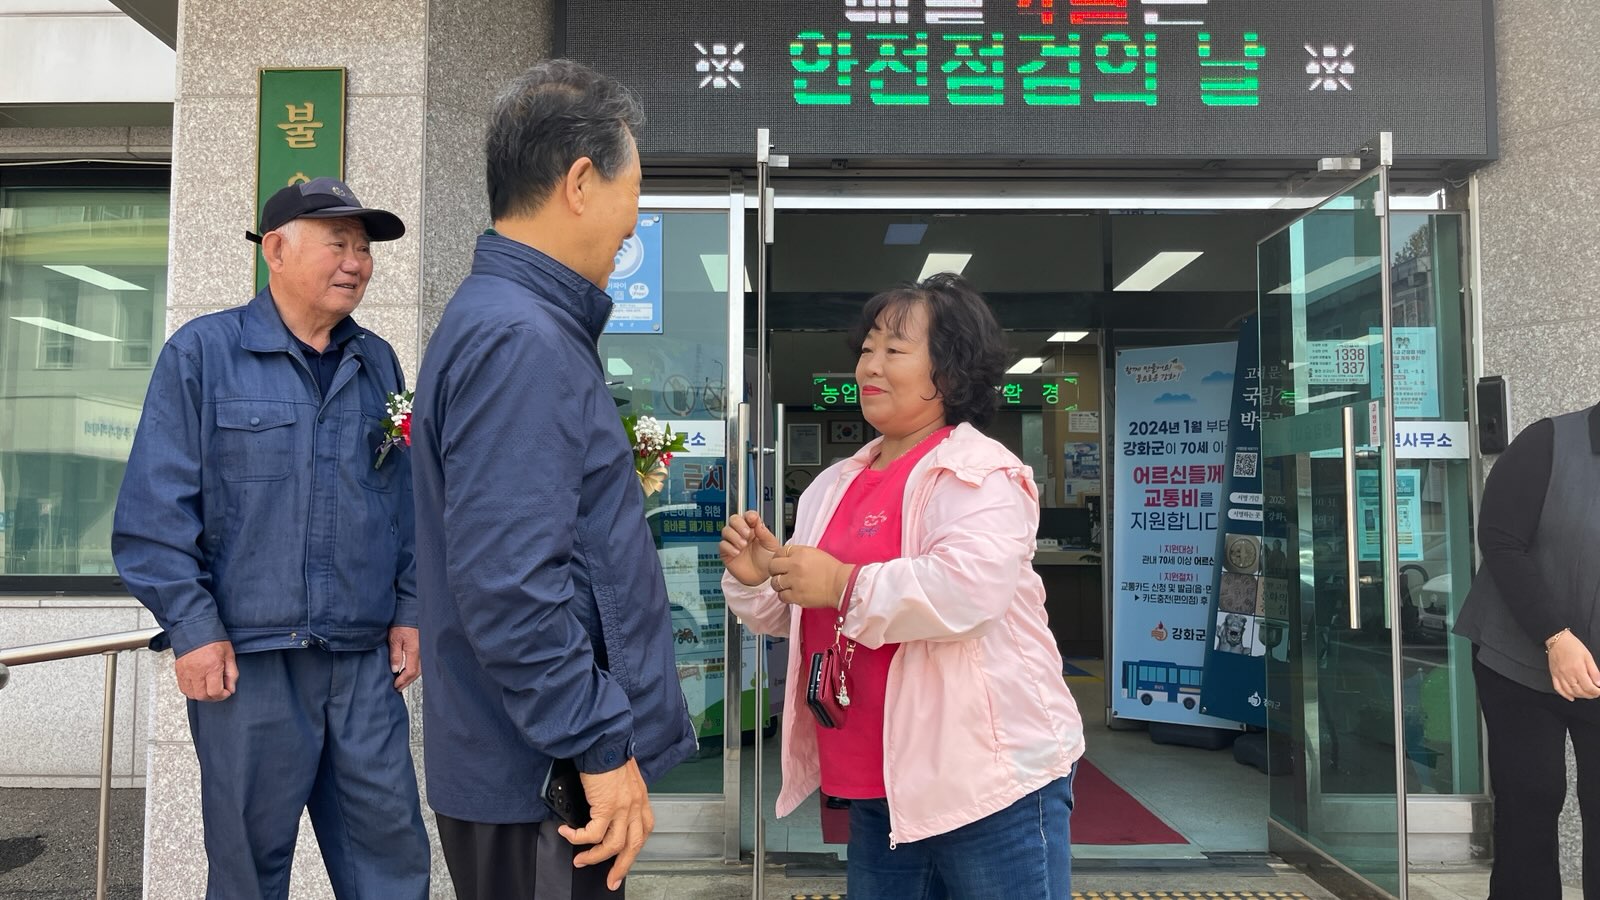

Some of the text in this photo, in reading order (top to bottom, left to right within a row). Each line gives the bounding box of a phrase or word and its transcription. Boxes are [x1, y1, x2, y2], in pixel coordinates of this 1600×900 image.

[790, 32, 1266, 106] 안전점검의 날
[1334, 348, 1365, 361] 1338
[1335, 361, 1365, 374] 1337
[820, 382, 856, 405] 농업
[1003, 382, 1059, 405] 환 경
[1129, 421, 1180, 436] 2024년
[1183, 419, 1203, 434] 1월
[1206, 419, 1230, 433] 부터
[1123, 441, 1229, 456] 강화군이 70세 이
[683, 463, 726, 491] 금지
[1133, 464, 1225, 485] 어르신들께
[1144, 488, 1214, 508] 교통비를
[705, 505, 721, 518] 위한
[663, 520, 688, 533] 올바른
[689, 520, 714, 533] 폐기물
[1164, 544, 1194, 555] 지원대상
[1159, 555, 1175, 566] 70세
[1177, 556, 1193, 566] 이상
[1120, 582, 1150, 592] 교통카드
[1168, 583, 1176, 593] 및
[1172, 628, 1206, 642] 강화군
